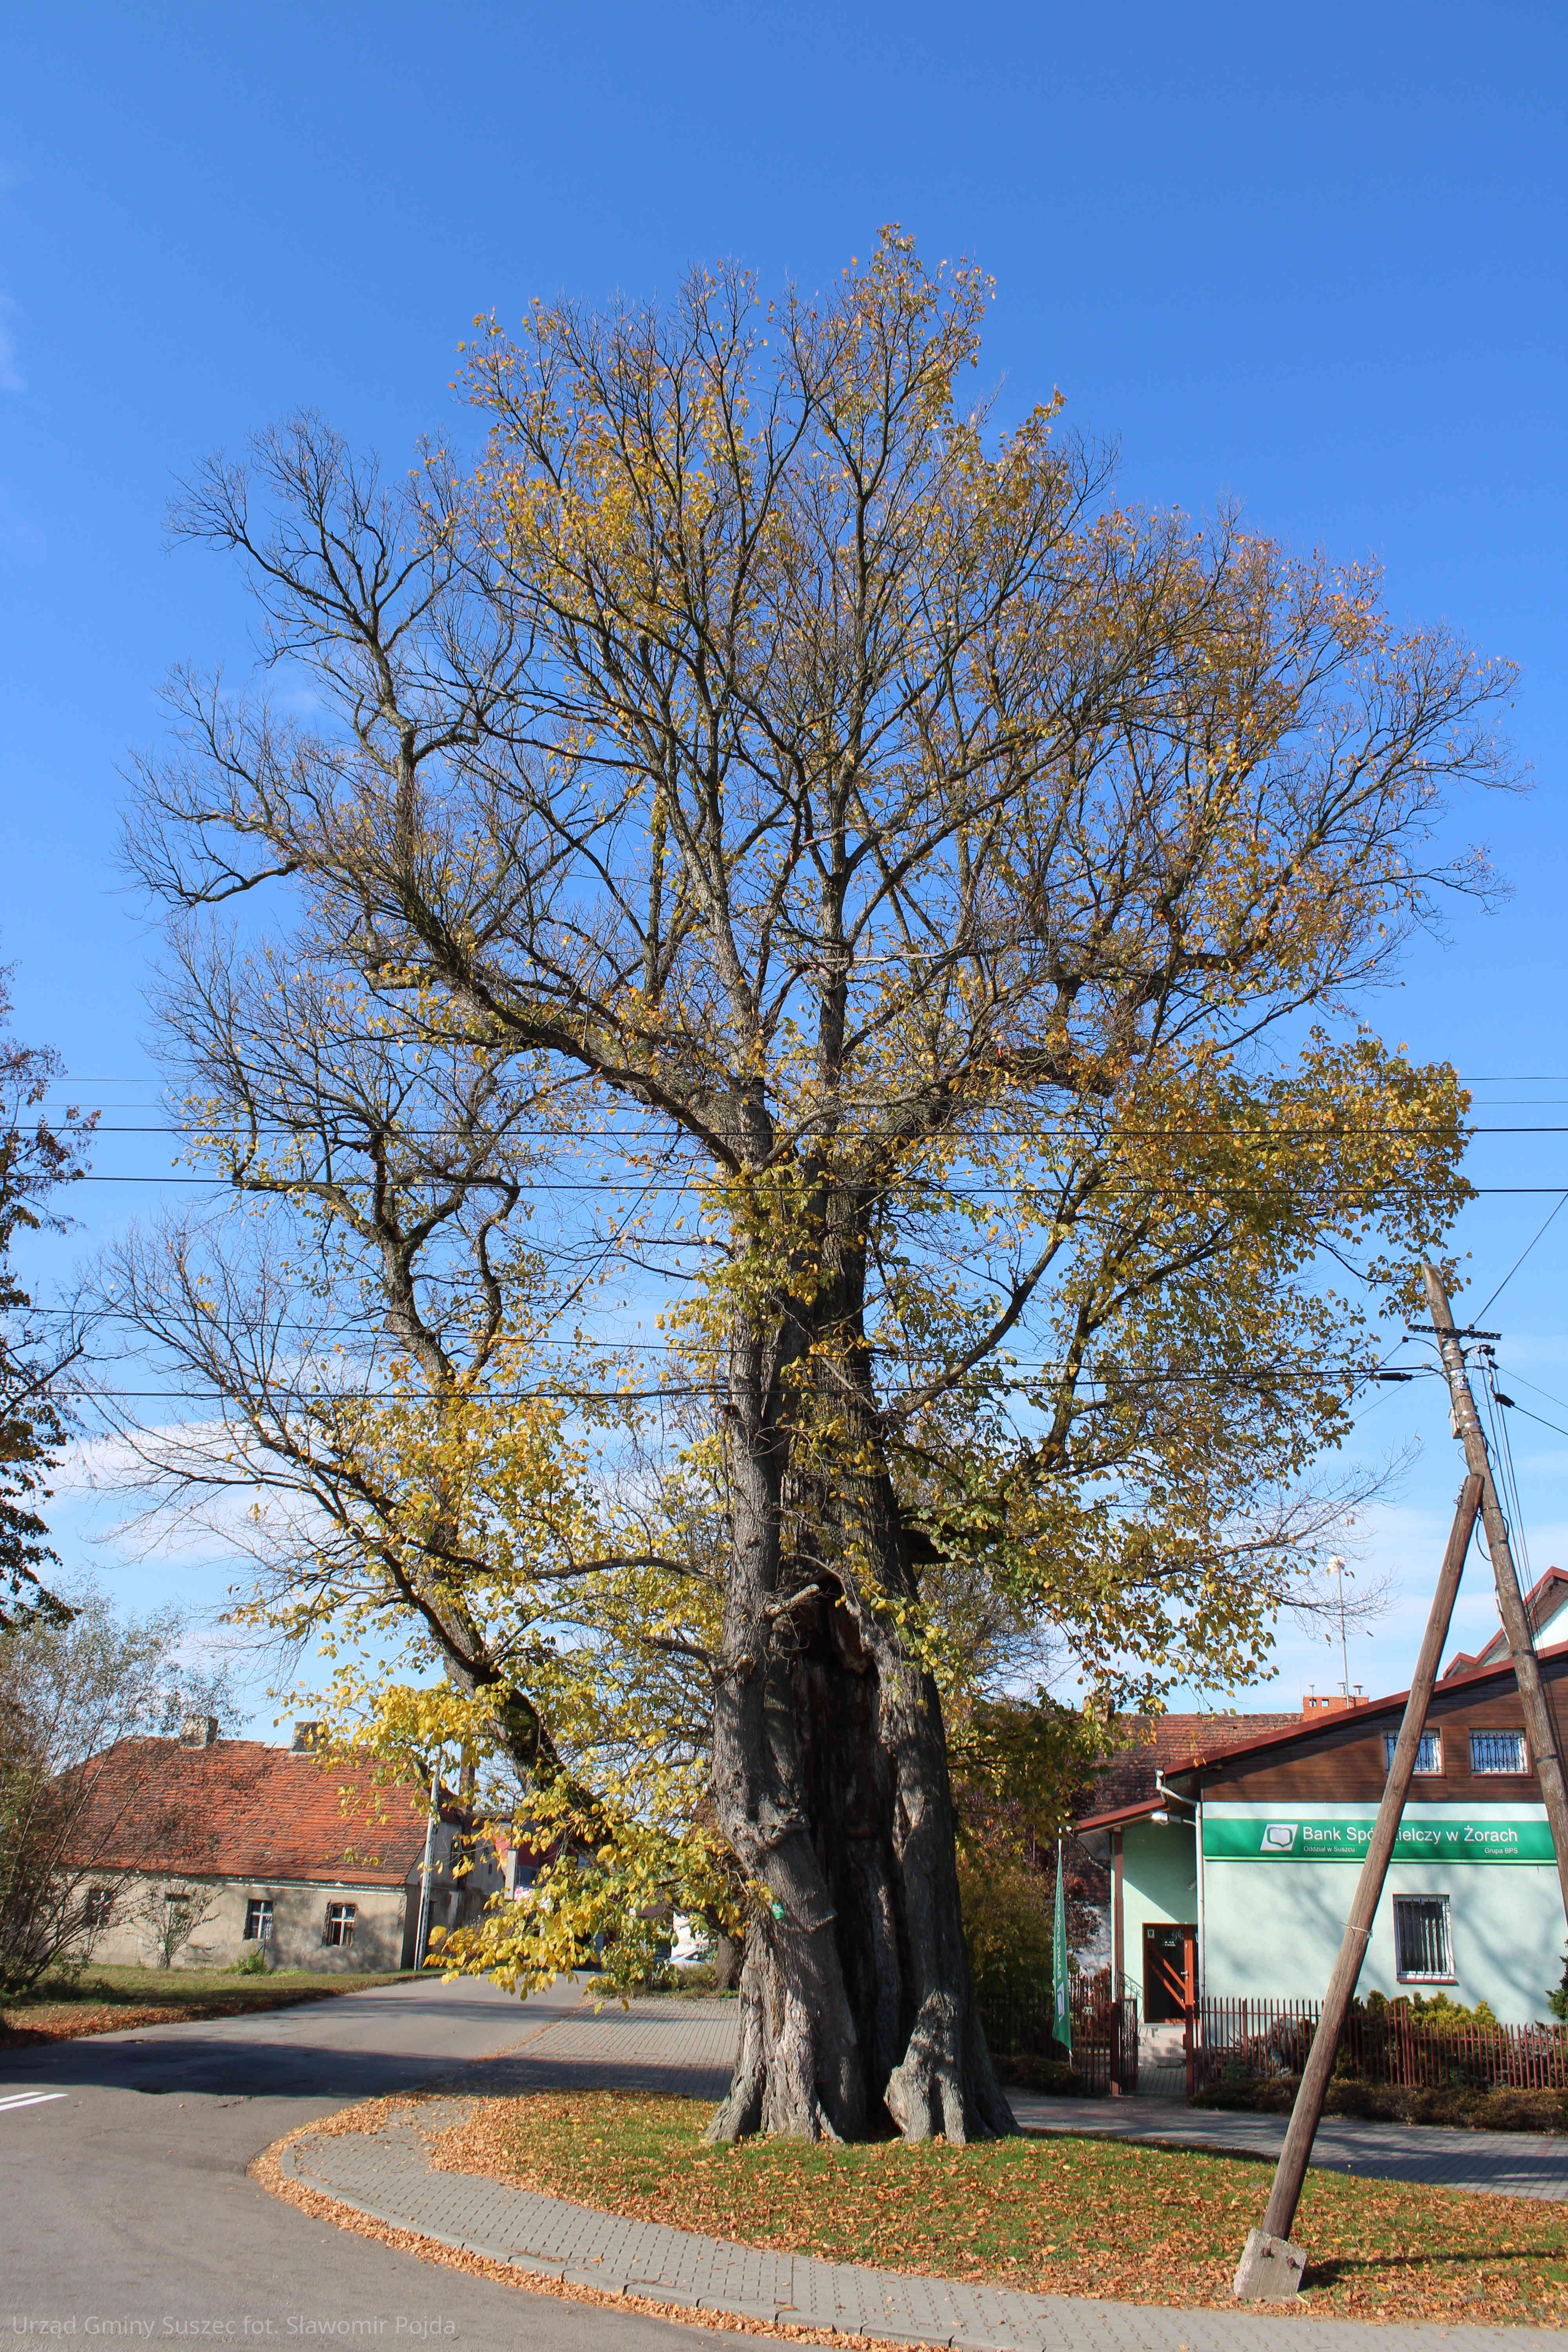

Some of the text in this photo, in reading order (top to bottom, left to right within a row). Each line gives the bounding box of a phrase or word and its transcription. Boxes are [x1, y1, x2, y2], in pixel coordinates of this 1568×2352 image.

[1303, 1825, 1518, 1844] Bank Spóielczy w Żorach
